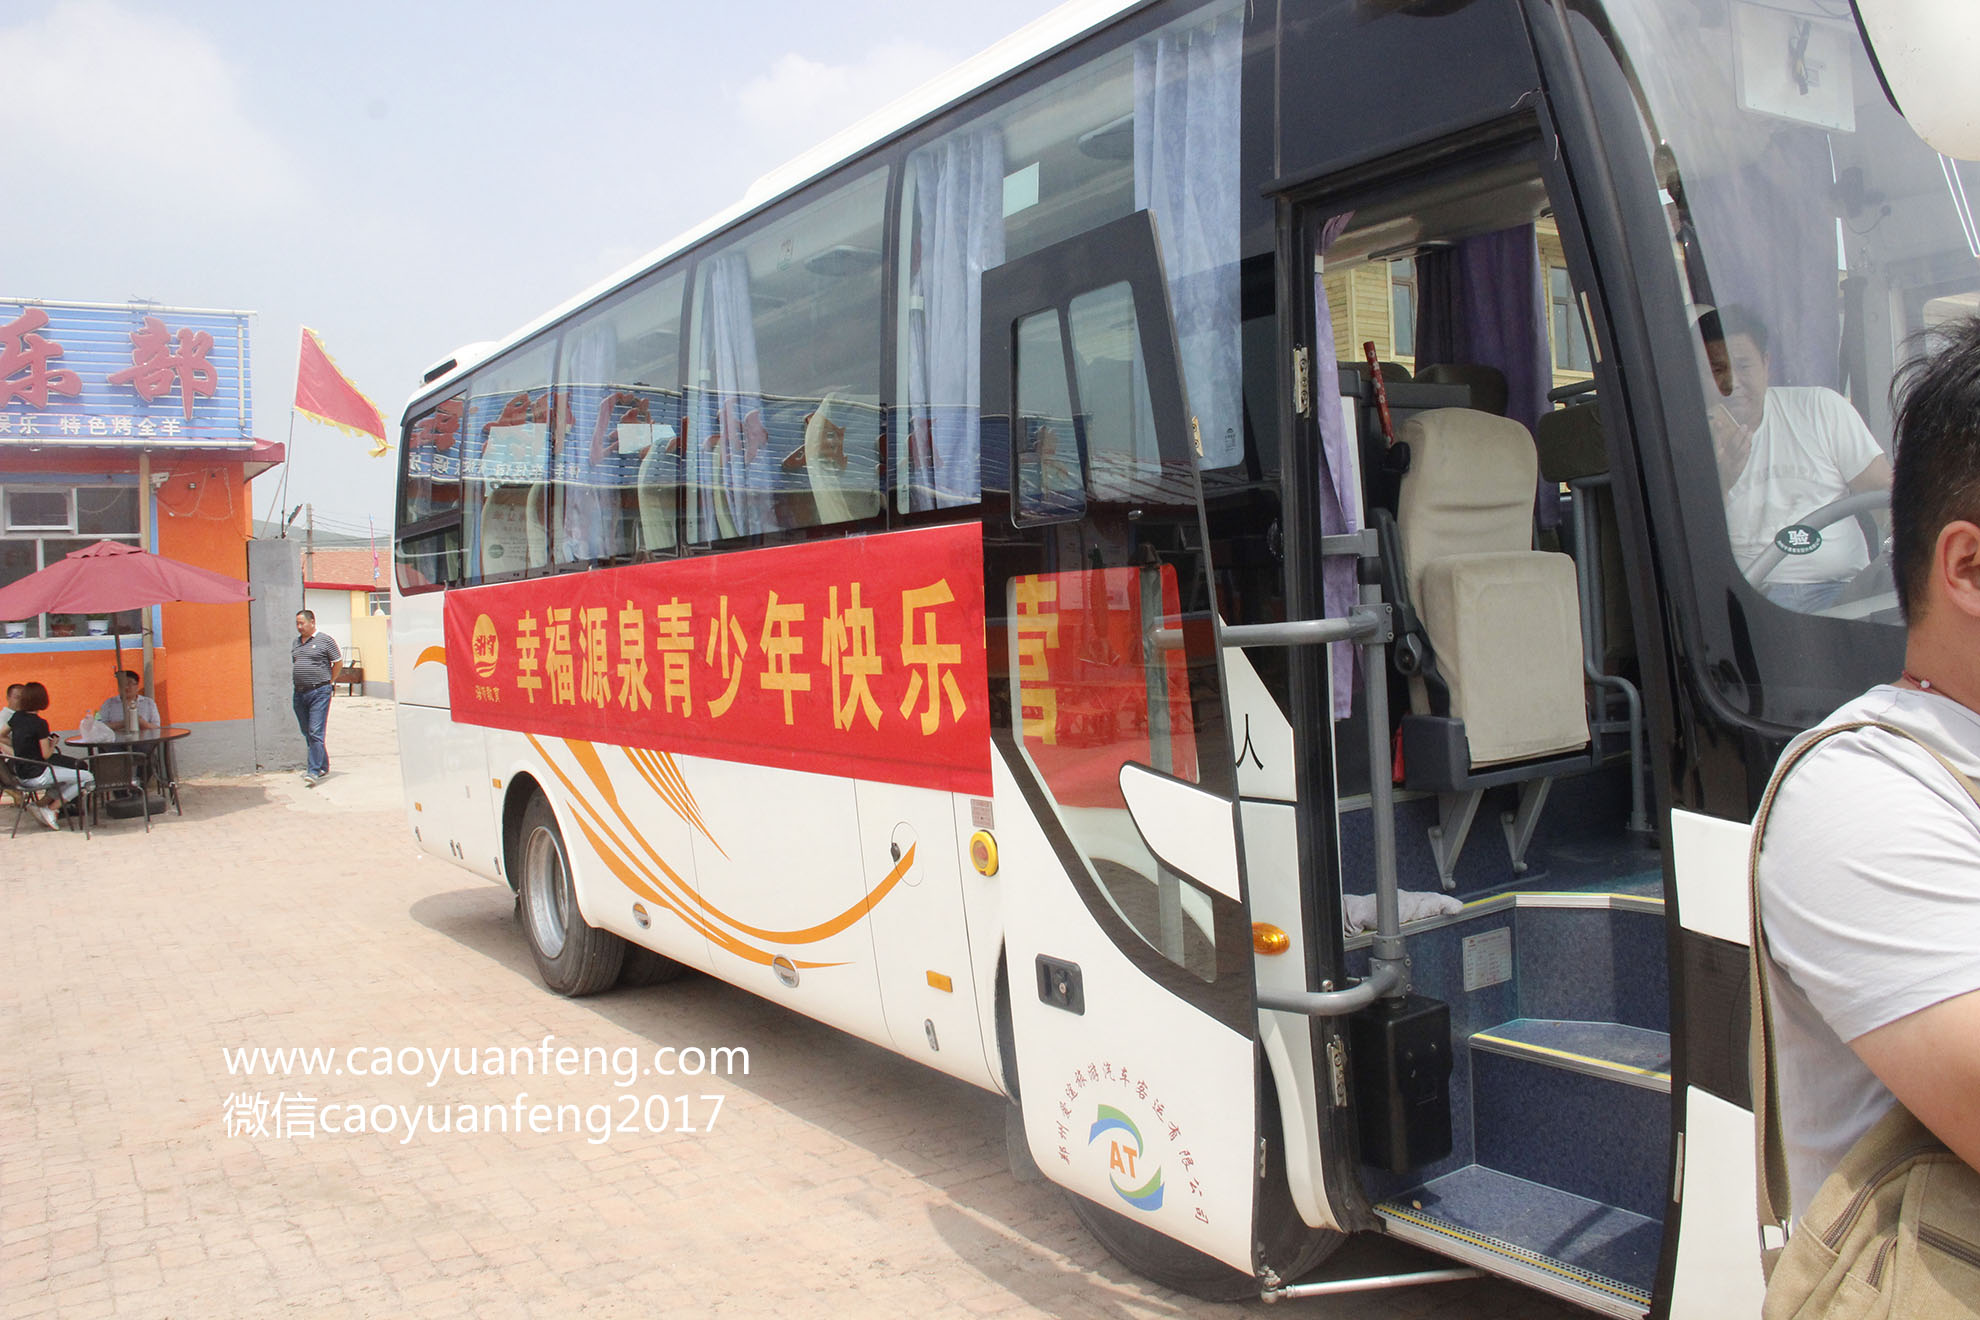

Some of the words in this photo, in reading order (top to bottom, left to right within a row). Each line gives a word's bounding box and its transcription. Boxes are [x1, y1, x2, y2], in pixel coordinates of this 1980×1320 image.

[60, 416, 182, 437] 特色烤全羊
[1109, 1140, 1138, 1179] AT
